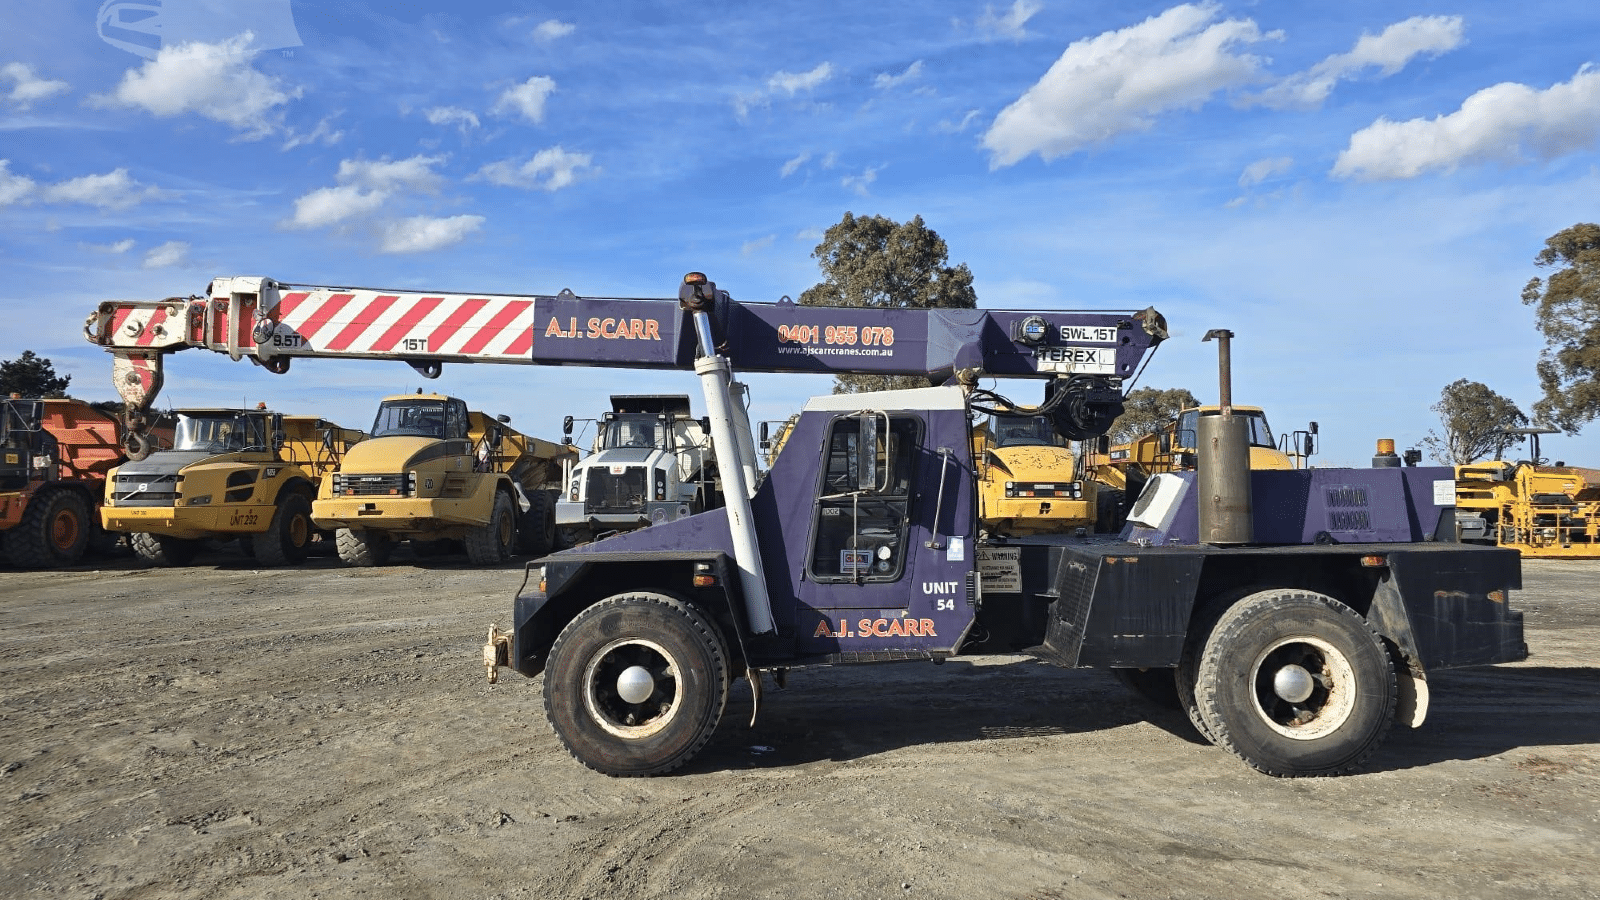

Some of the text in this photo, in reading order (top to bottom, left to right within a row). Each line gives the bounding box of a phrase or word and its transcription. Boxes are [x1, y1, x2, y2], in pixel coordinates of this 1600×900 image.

[544, 316, 661, 340] A.J. SCARR
[273, 334, 300, 347] 9.5T
[778, 324, 894, 346] 0401 955 078
[402, 338, 427, 350] 15T
[778, 345, 893, 357] www.ajscarrcranes.com.au
[1040, 350, 1096, 362] TEREX
[922, 581, 959, 594] UNIT
[937, 598, 955, 611] 54
[813, 618, 938, 638] A.J. SCARR
